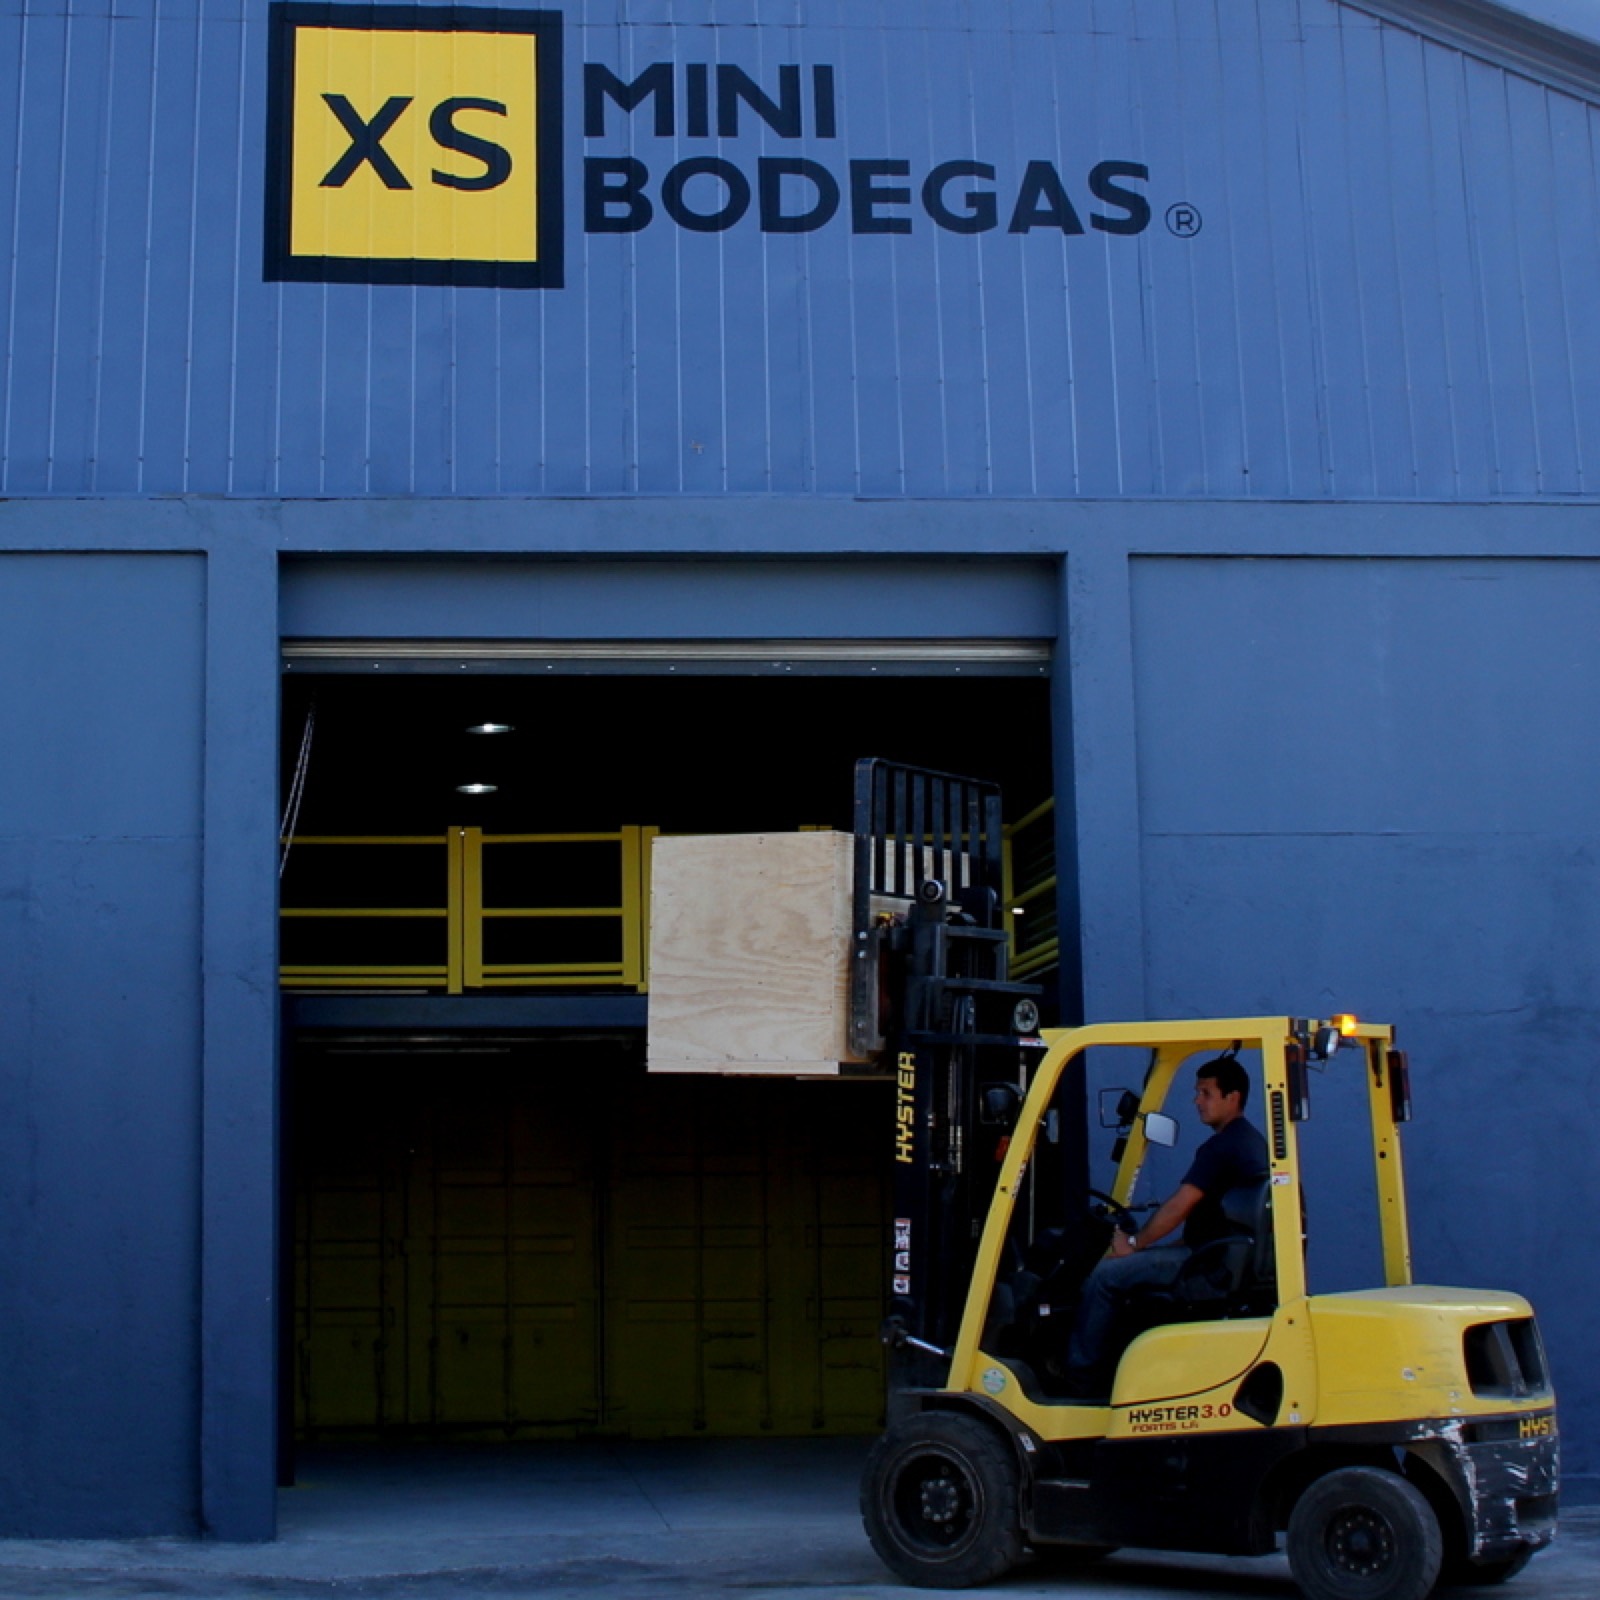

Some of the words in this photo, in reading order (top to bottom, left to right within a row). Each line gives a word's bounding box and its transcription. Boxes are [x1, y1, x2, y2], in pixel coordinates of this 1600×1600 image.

[583, 62, 836, 138] MINI
[318, 93, 512, 192] XS
[583, 156, 1151, 235] BODEGAS
[895, 1051, 916, 1164] HYSTER
[1128, 1405, 1199, 1423] HYSTER
[1200, 1403, 1233, 1419] 3.0
